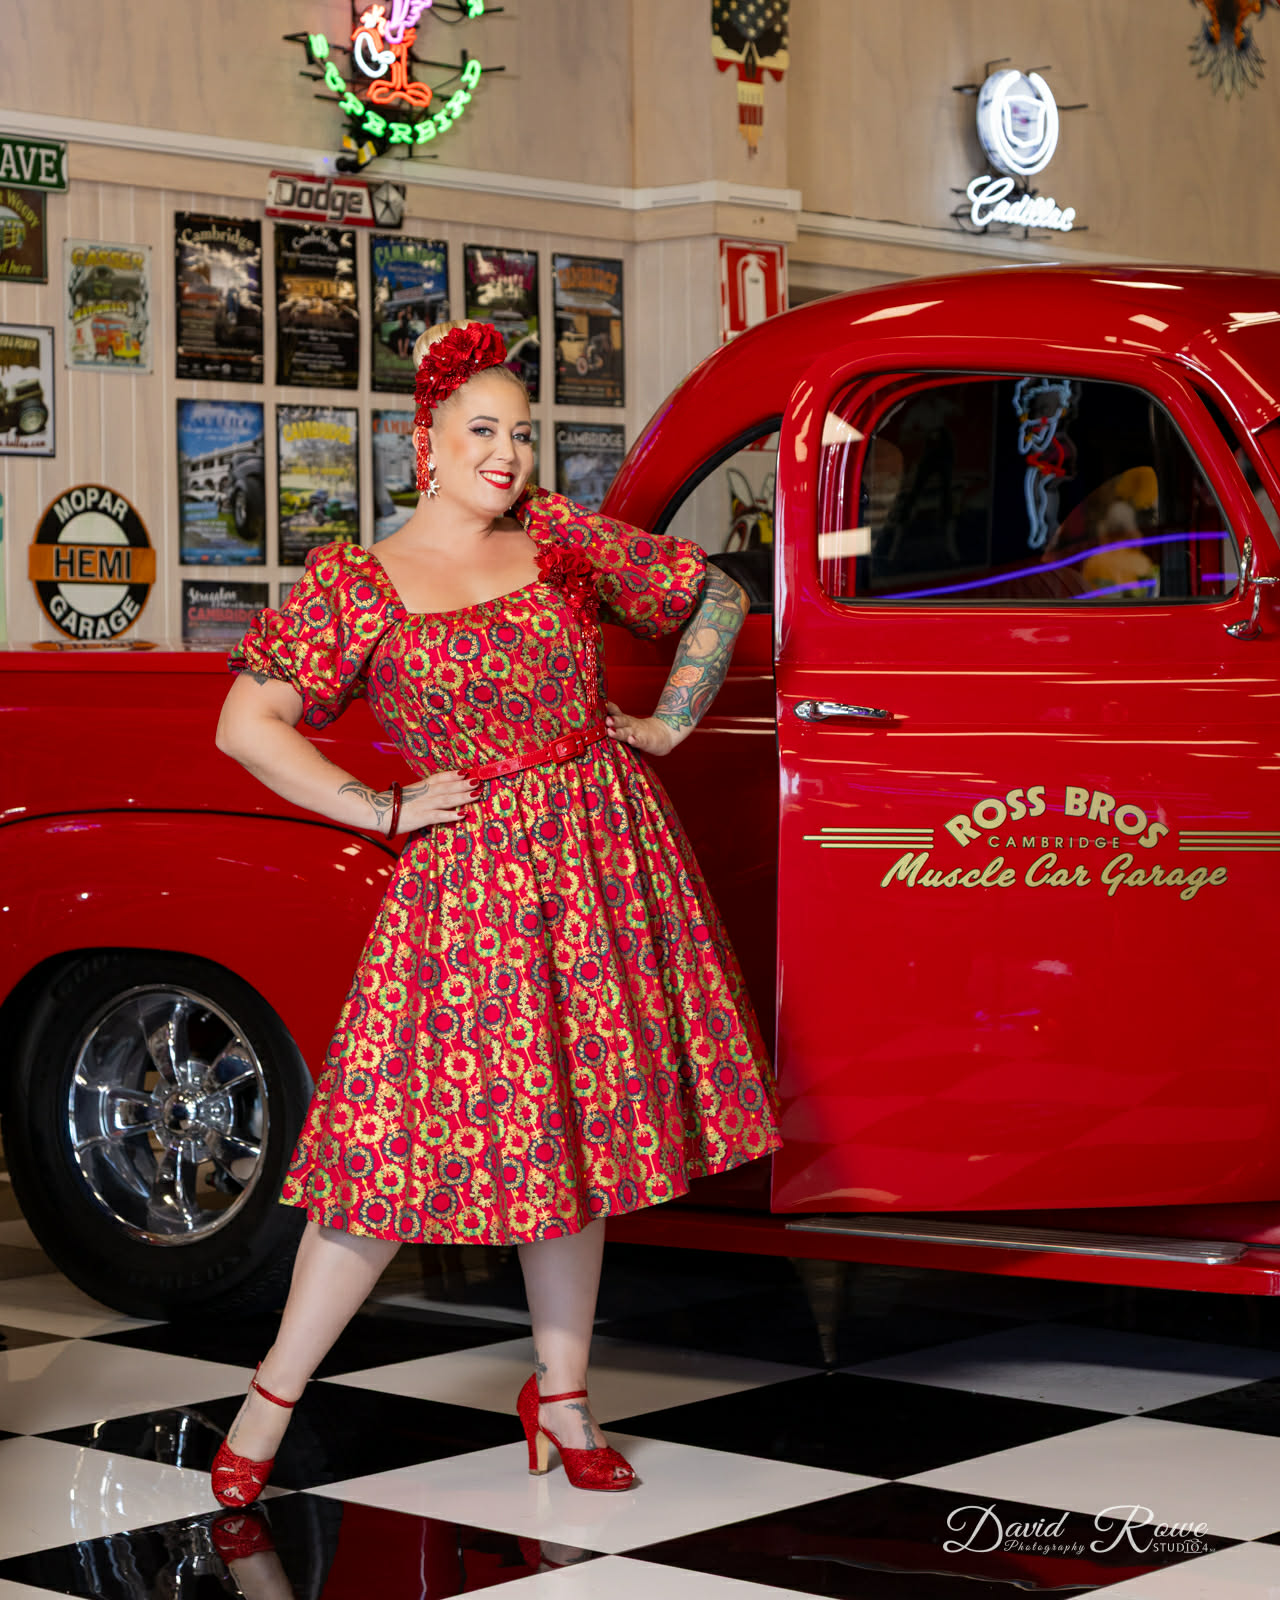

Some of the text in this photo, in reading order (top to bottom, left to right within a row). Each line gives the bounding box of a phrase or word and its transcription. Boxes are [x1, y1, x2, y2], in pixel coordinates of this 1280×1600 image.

[309, 33, 481, 144] SUPERBIRD
[0, 144, 58, 183] AVE
[276, 178, 364, 221] Dodge
[967, 175, 1076, 232] Cadillac
[182, 224, 255, 251] Cambridge
[557, 430, 624, 448] CAMBRIDGE
[53, 486, 129, 525] MOPAR
[54, 547, 132, 581] HEMI
[50, 595, 141, 640] GARAGE
[944, 786, 1169, 849] ROSS BROS
[988, 835, 1121, 849] CAMBRIDGE
[881, 852, 1228, 900] Muscle Car Garage
